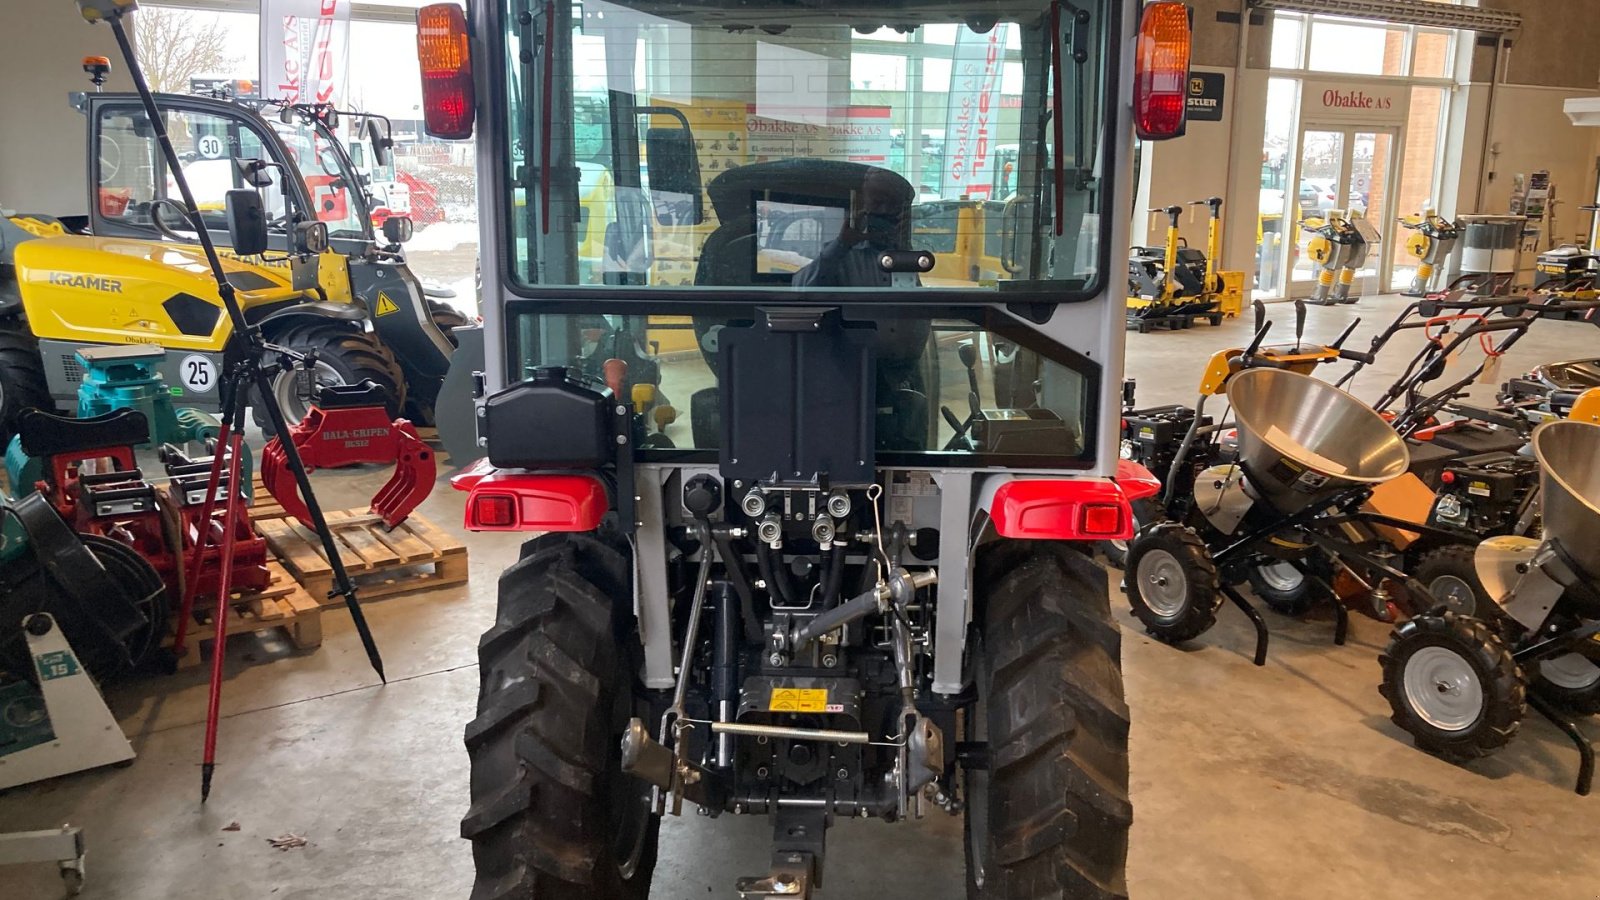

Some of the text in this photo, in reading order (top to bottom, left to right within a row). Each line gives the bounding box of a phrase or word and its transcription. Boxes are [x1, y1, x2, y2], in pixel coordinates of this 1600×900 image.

[1187, 98, 1217, 107] STLER
[1375, 97, 1392, 109] A/S
[203, 139, 219, 155] 30
[49, 272, 123, 294] KRAMER
[188, 361, 209, 385] 25
